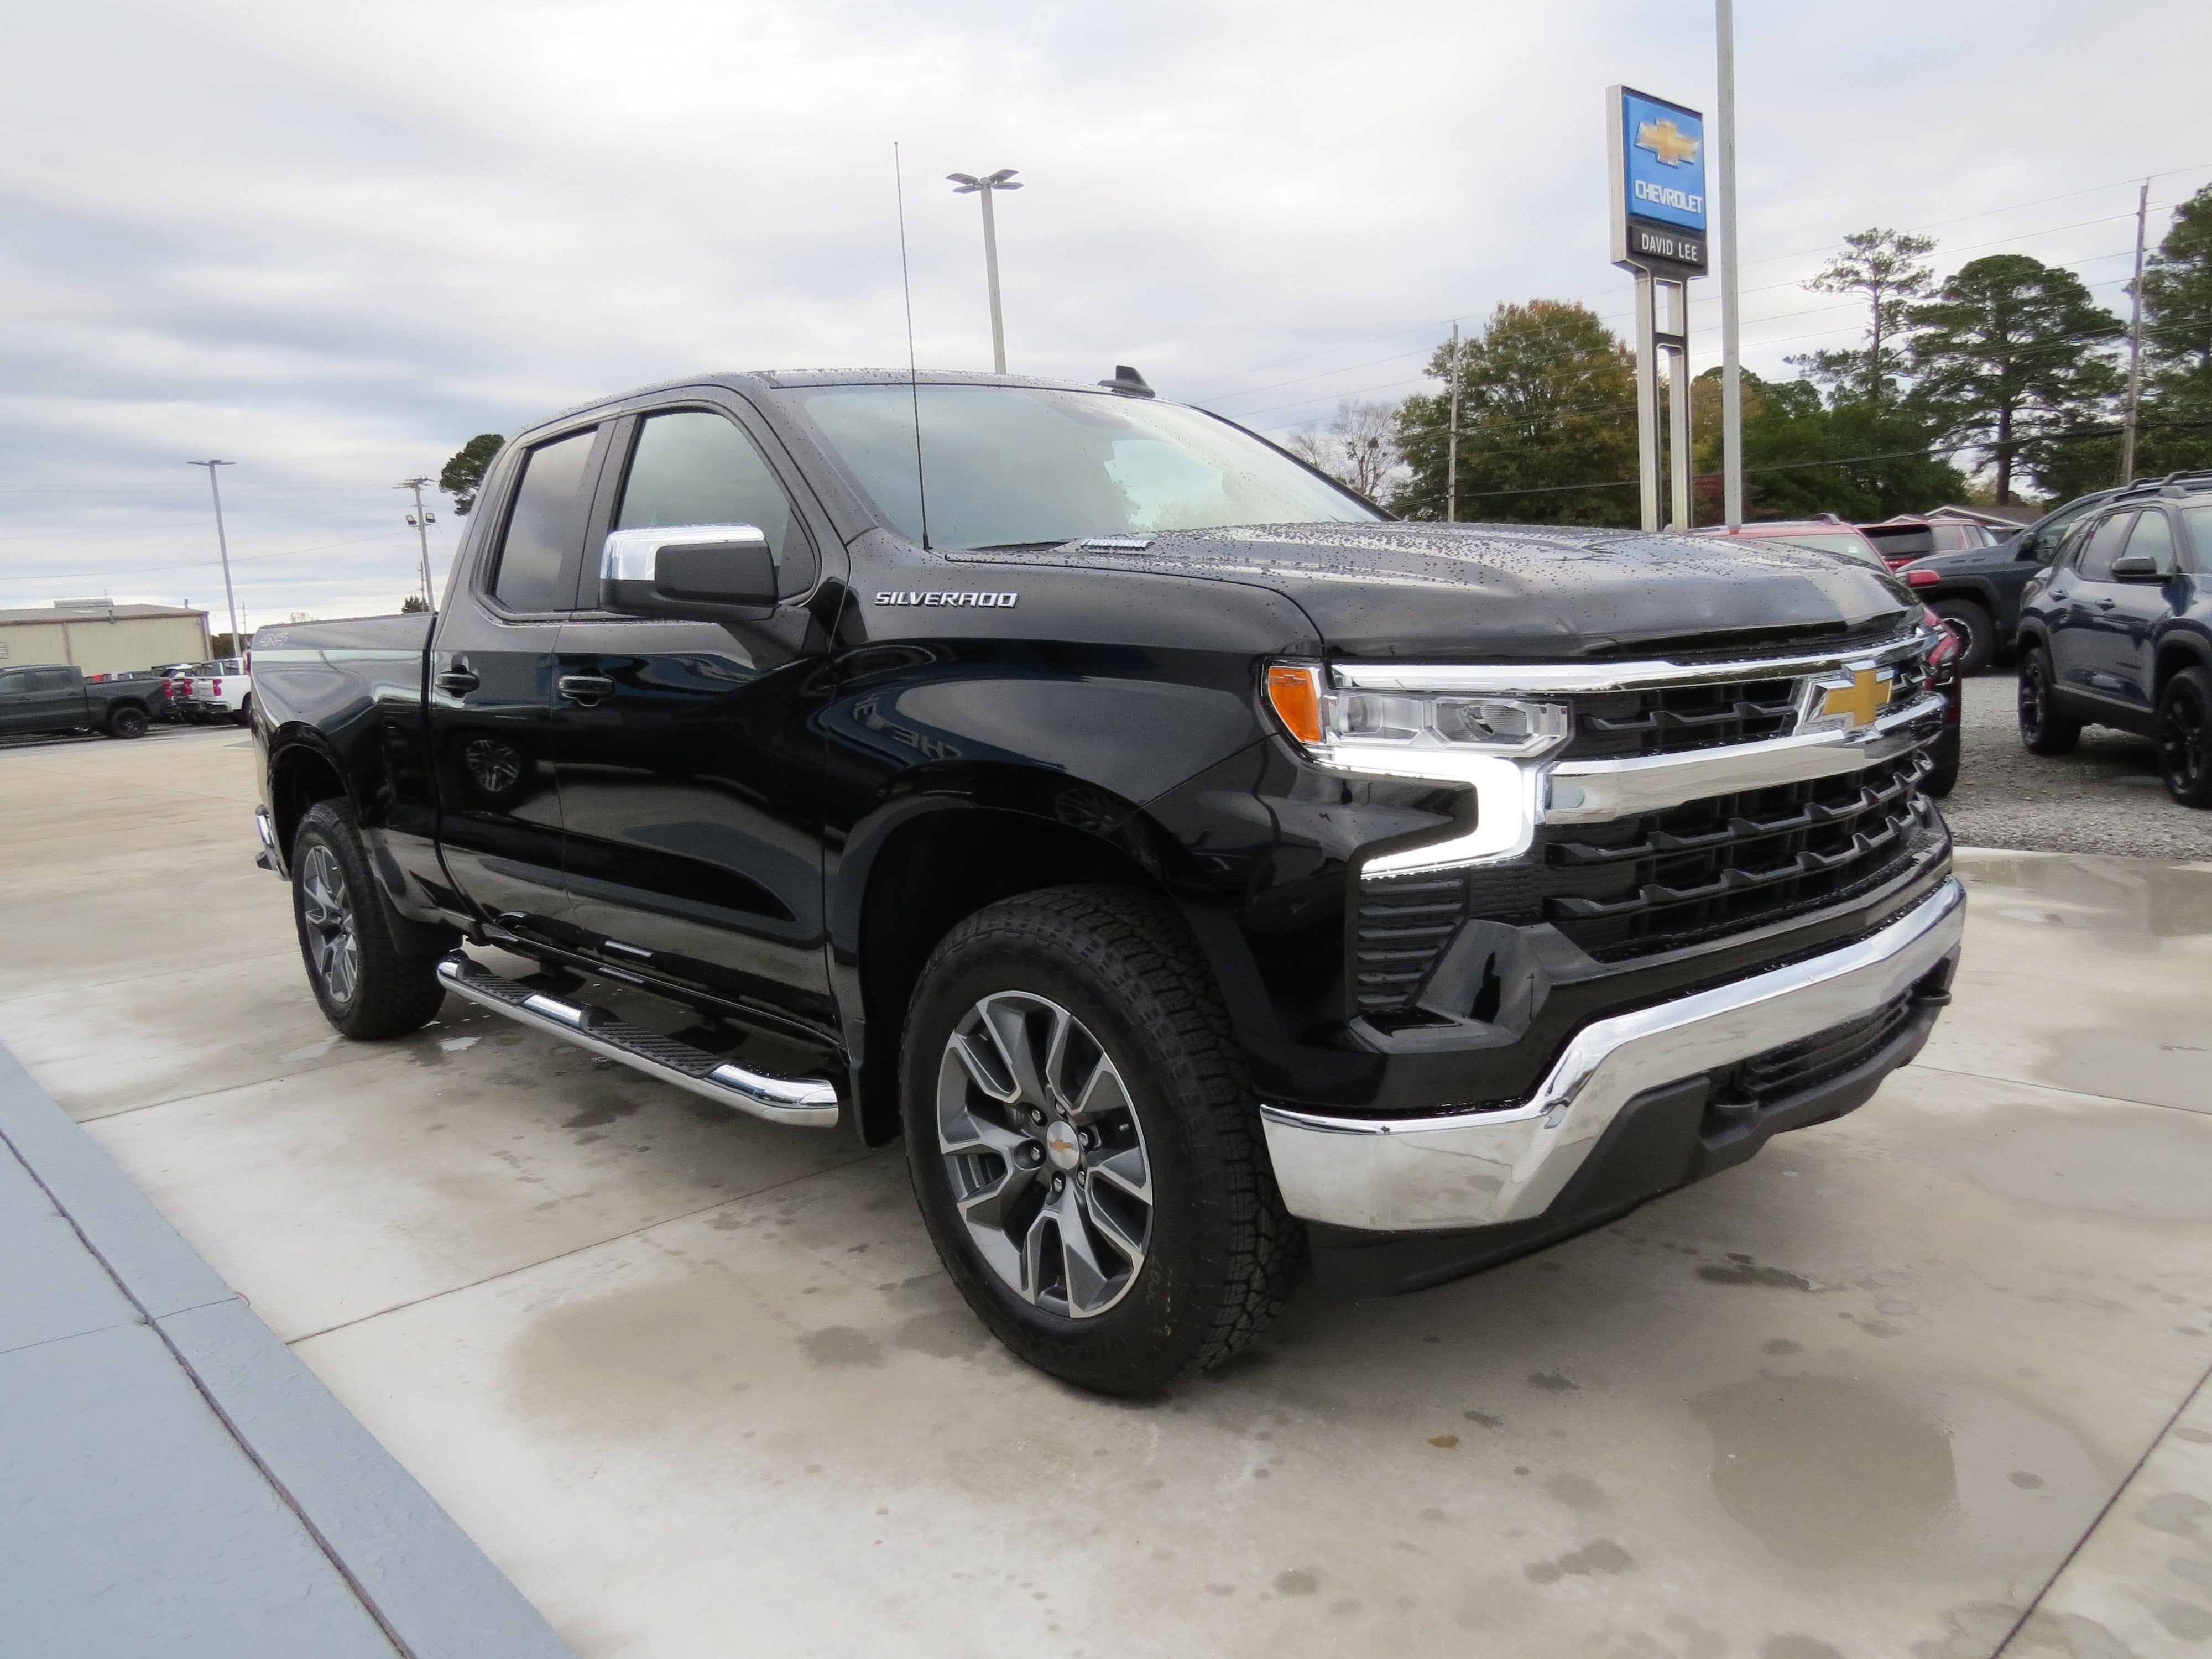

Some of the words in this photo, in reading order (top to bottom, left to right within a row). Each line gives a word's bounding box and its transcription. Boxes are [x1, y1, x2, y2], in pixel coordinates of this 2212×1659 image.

[1635, 179, 1703, 214] CHEVROLET
[1641, 233, 1673, 256] DAVID
[1678, 242, 1698, 262] LEE
[874, 592, 1019, 607] SILVERADO
